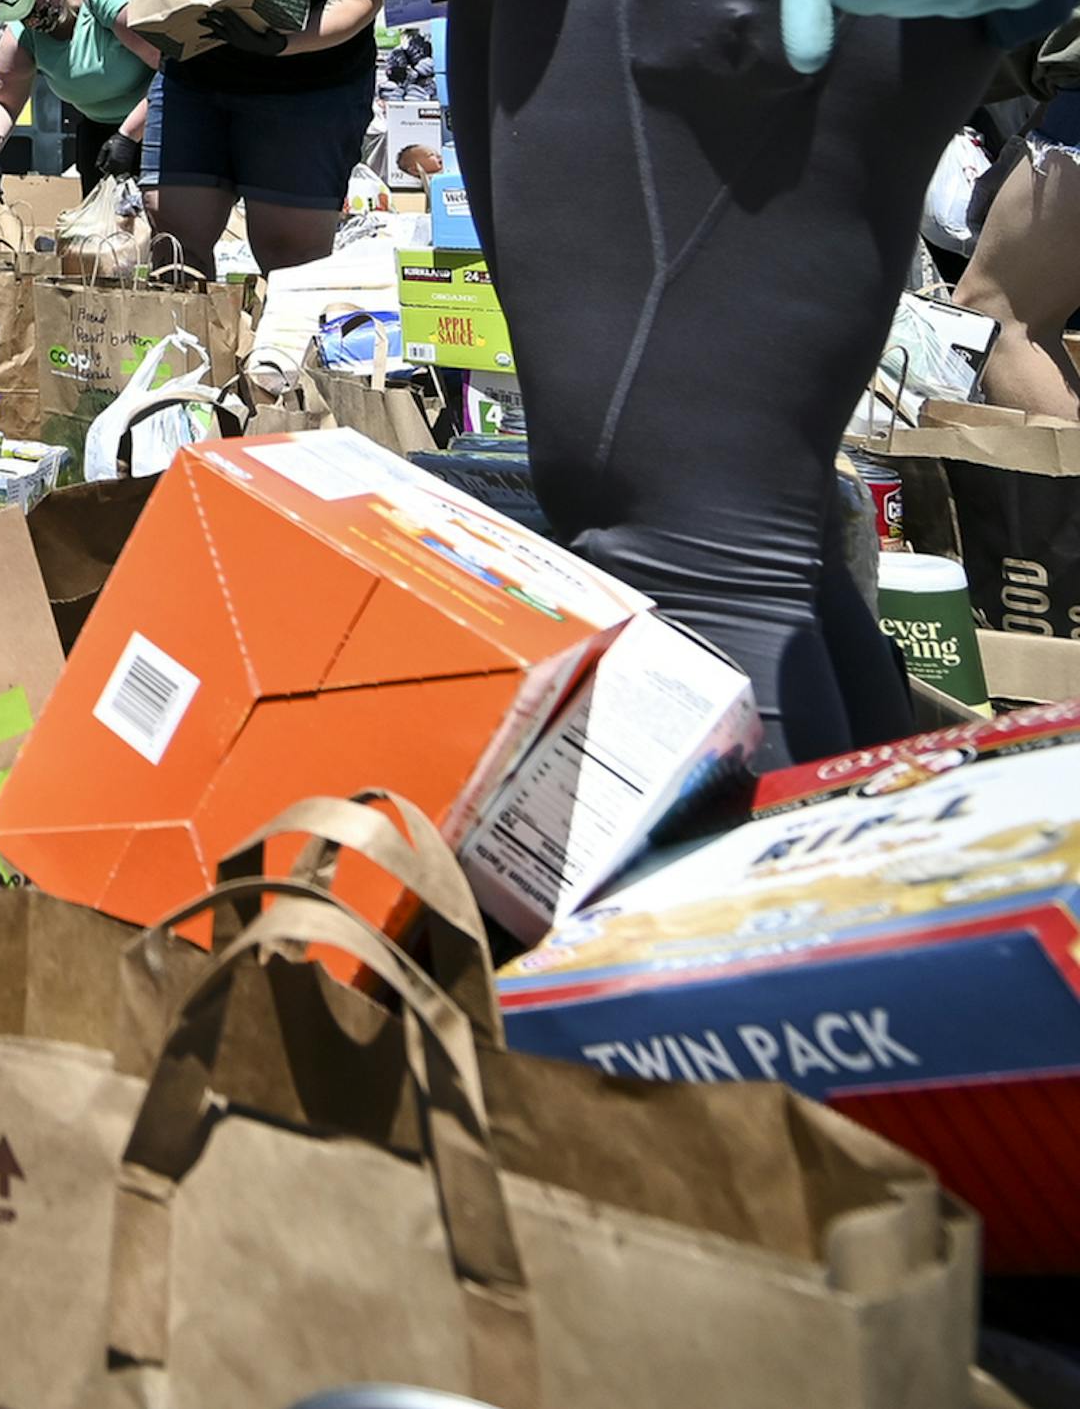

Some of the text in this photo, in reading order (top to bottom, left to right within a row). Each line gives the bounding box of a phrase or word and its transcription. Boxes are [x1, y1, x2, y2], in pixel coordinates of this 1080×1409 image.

[438, 316, 472, 333] APPLE
[438, 330, 475, 347] SAUCE
[878, 618, 943, 640] ever
[581, 1006, 923, 1085] TWIN PACK
